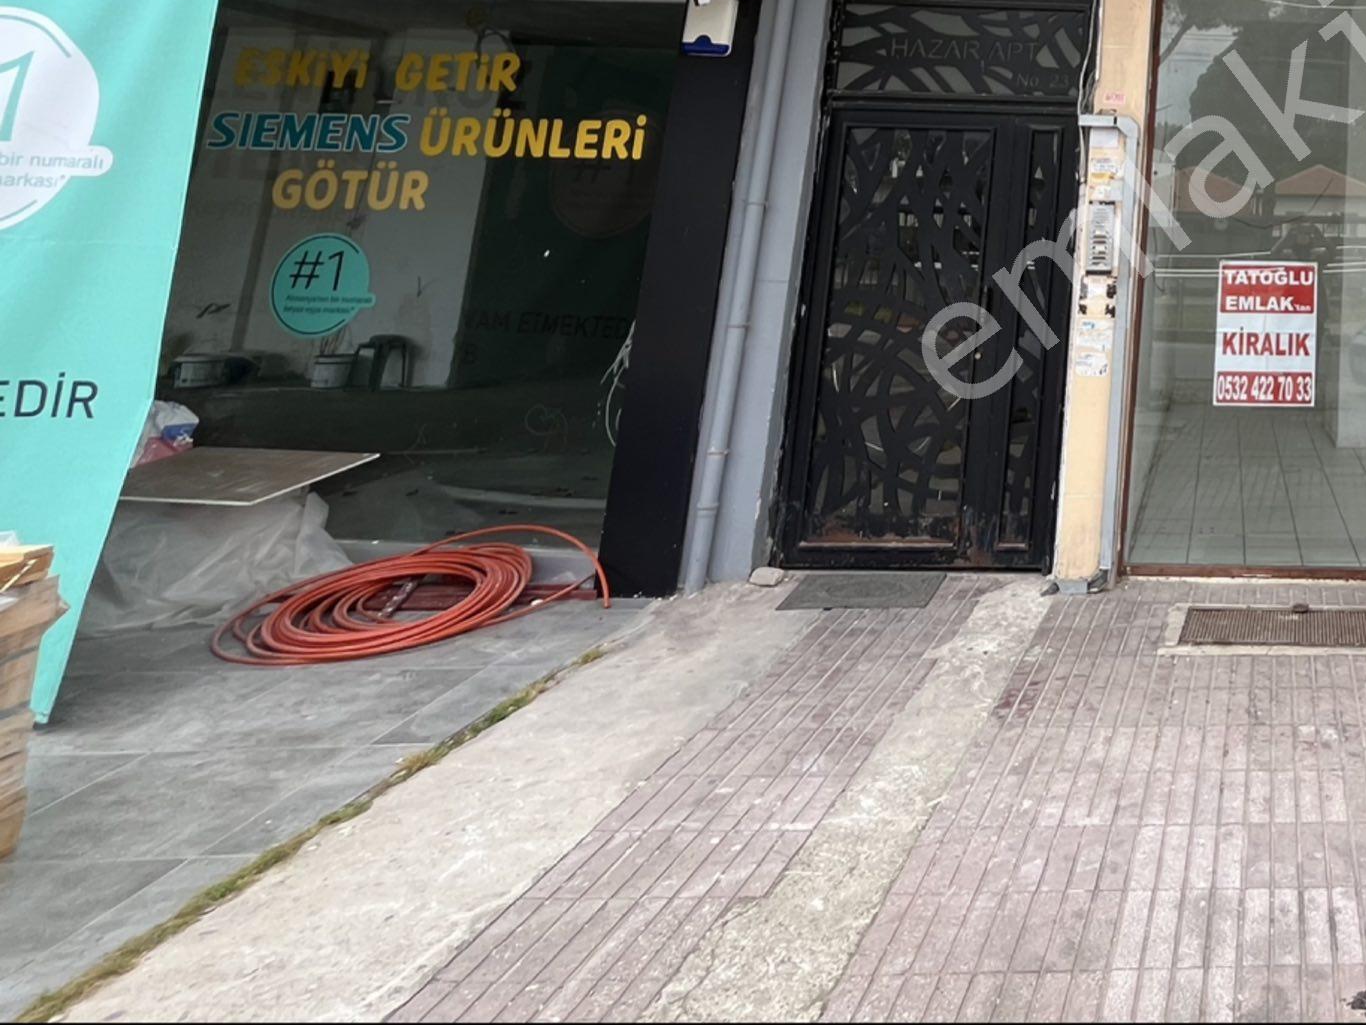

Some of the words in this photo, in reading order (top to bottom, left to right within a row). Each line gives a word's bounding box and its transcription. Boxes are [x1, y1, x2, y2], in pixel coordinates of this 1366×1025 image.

[234, 46, 371, 90] ESKİYİ
[395, 50, 522, 94] GETİR
[890, 36, 981, 60] HAZAR
[988, 40, 1040, 63] APT
[206, 111, 412, 153] SIEMENS
[419, 107, 648, 161] ÜRÜNLERİ
[271, 159, 431, 211] GÖTÜR
[289, 250, 345, 291] #1
[1223, 265, 1313, 286] TATOĞLU
[1217, 375, 1248, 400] 0532
[1252, 376, 1275, 401] 422
[1278, 376, 1293, 401] 70
[1296, 376, 1312, 401] 33
